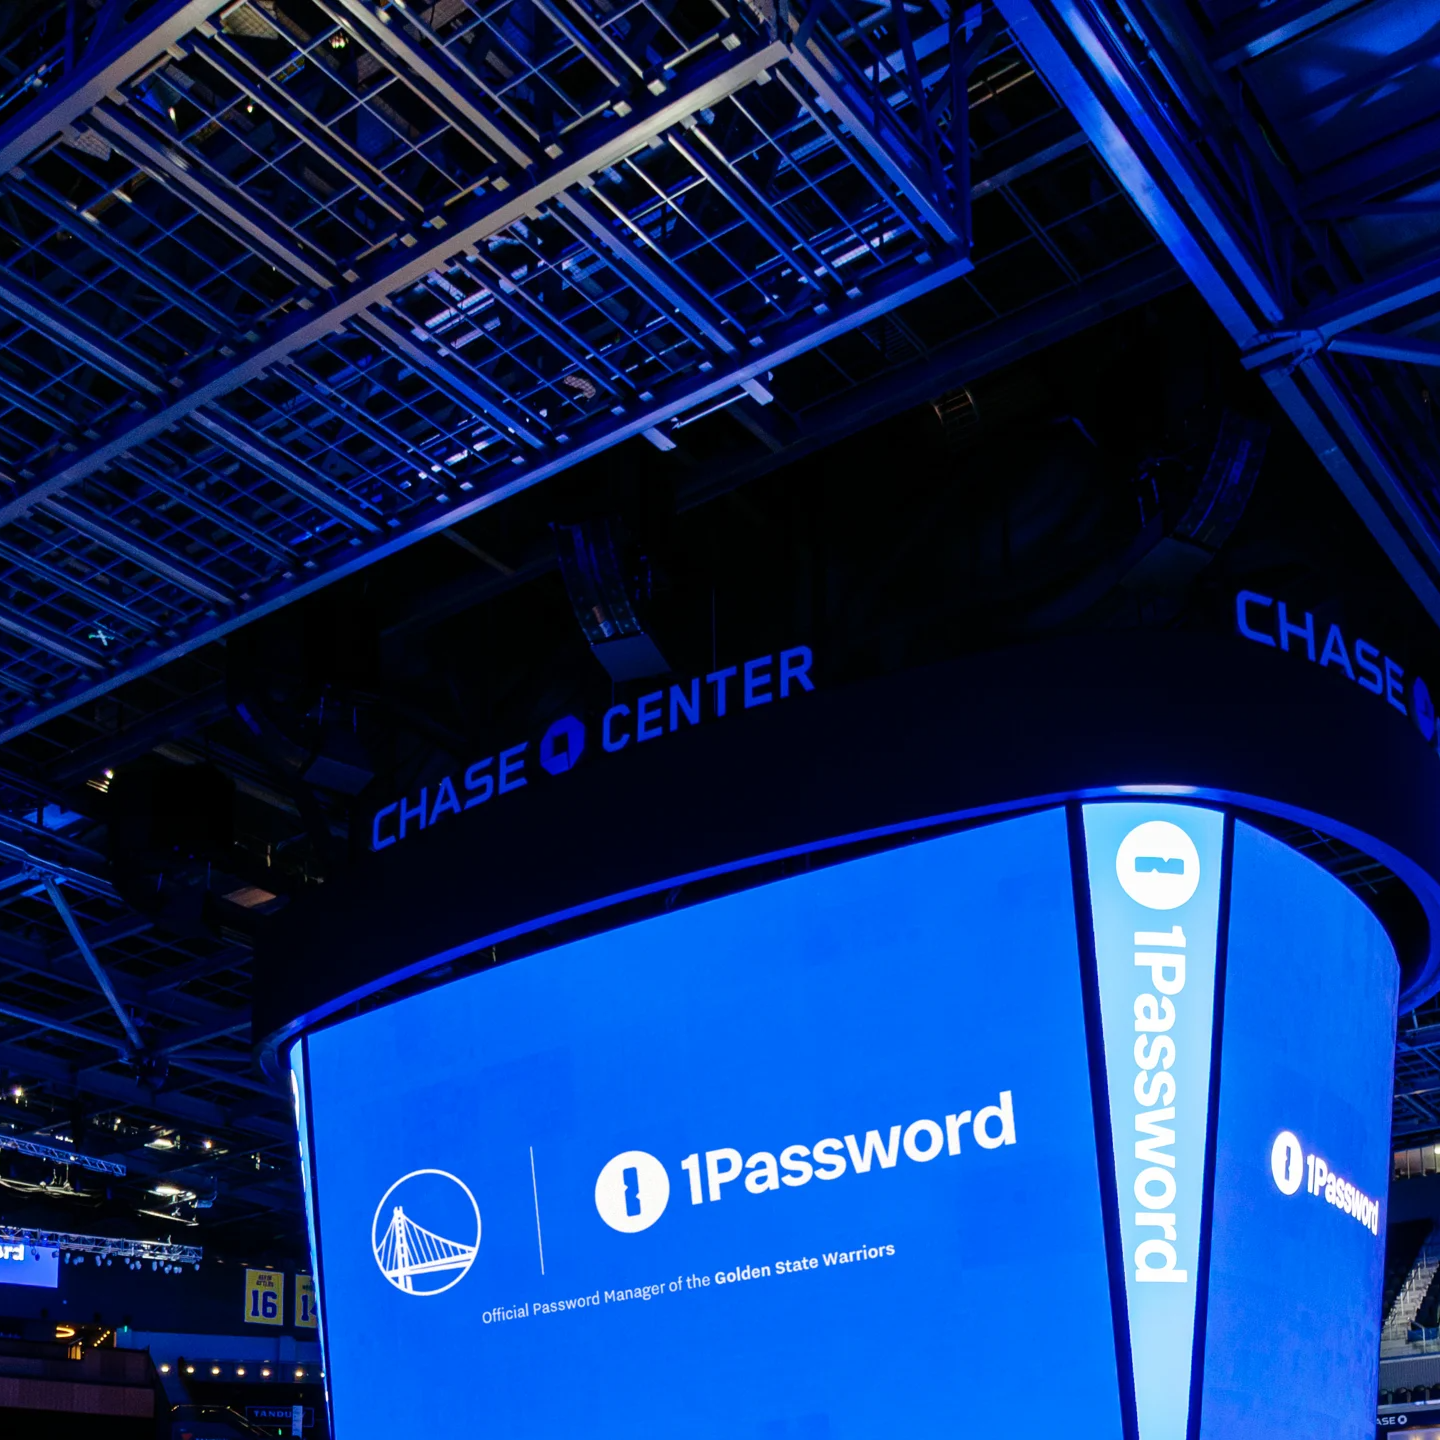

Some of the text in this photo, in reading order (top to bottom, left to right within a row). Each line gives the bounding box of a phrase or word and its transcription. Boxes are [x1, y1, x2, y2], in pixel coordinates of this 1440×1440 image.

[1235, 588, 1408, 717] CHASE
[371, 645, 815, 852] CHASE CENTER
[680, 1089, 1017, 1205] 1Password
[1132, 925, 1188, 1283] 1Password
[1306, 1153, 1380, 1236] 1Password
[250, 1289, 278, 1319] 16
[482, 1244, 896, 1324] Official Password Manager of the Golden State Warriors
